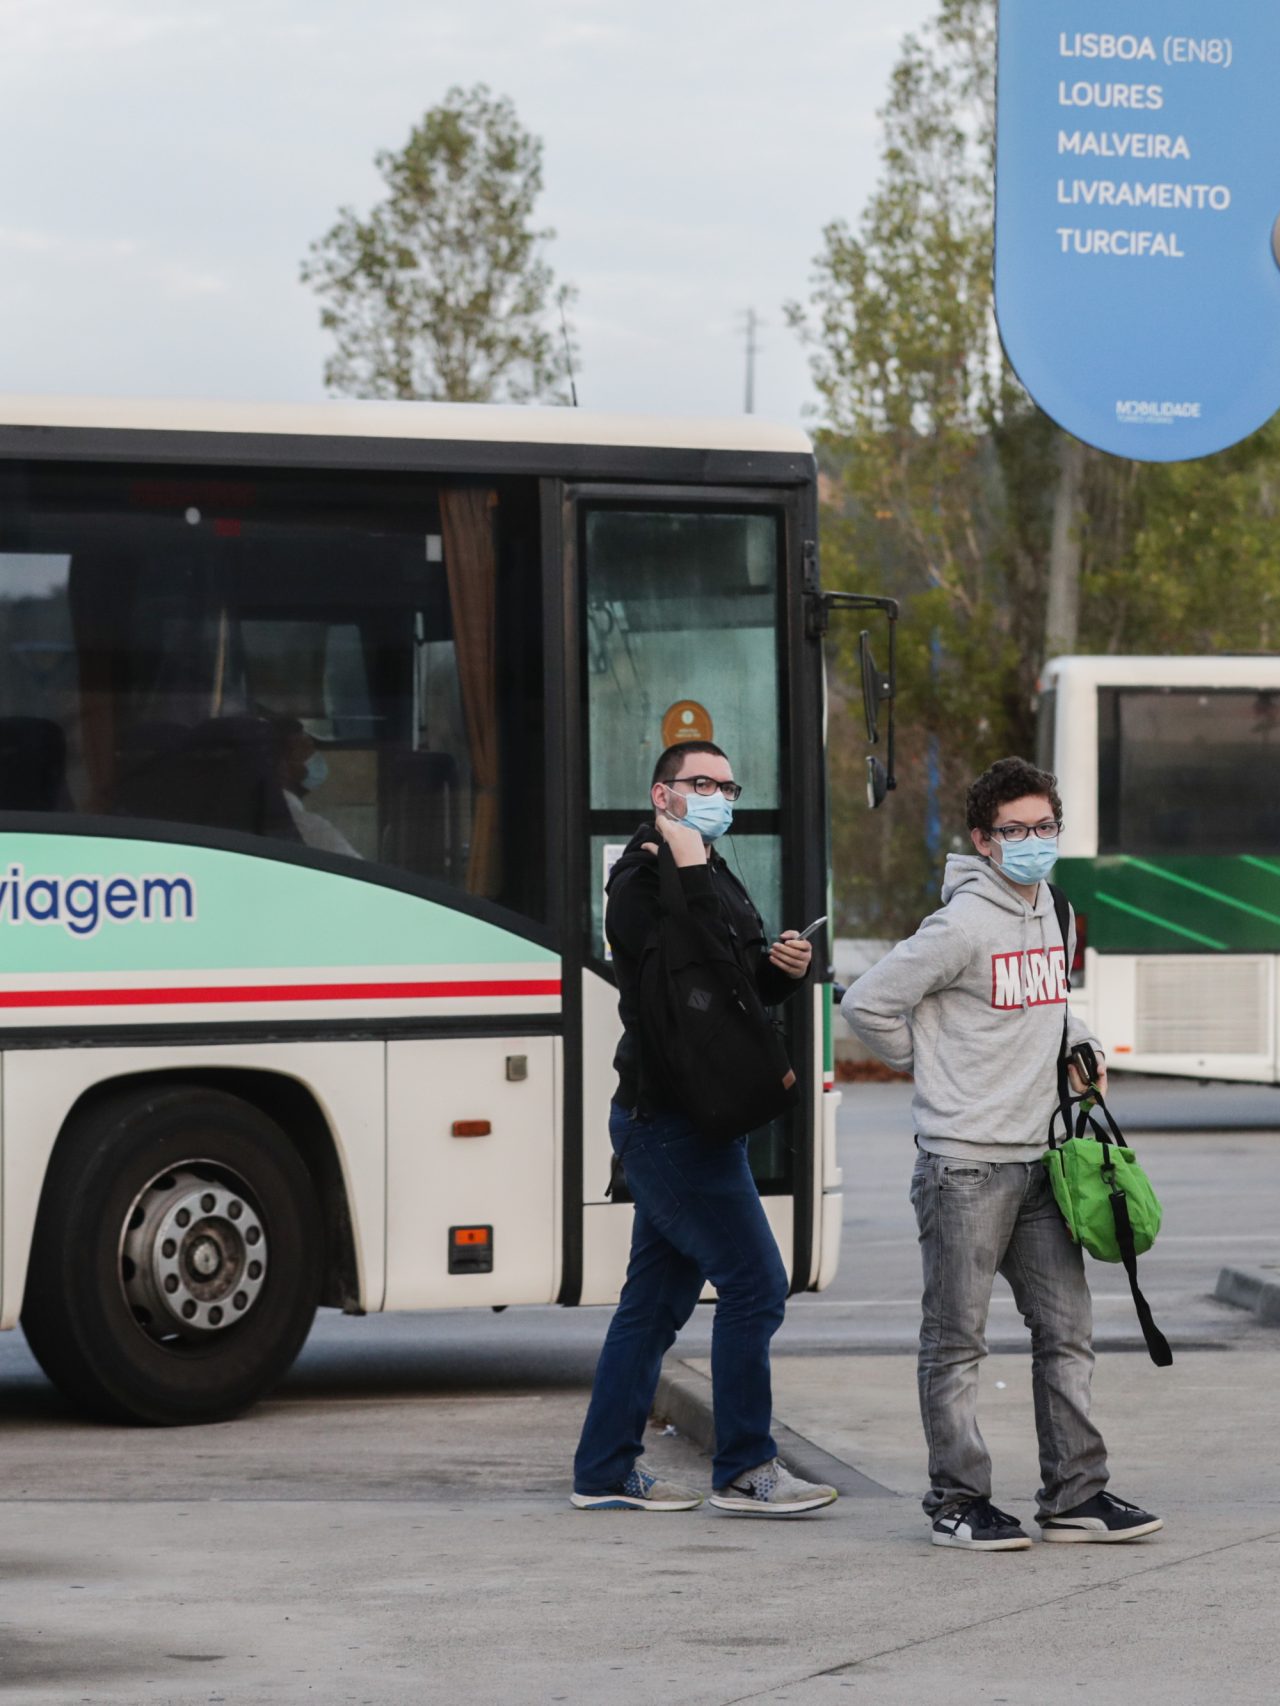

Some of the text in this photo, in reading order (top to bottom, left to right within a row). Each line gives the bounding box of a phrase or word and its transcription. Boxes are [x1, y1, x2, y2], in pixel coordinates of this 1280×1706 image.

[1059, 32, 1233, 68] LISBOA (EN8)
[1058, 80, 1164, 110] LOURES
[1057, 130, 1191, 160] MALVEIRA
[1057, 179, 1231, 210] LIVRAMENTO
[1056, 228, 1185, 257] TURCIFAL
[995, 950, 1067, 1006] MARVE
